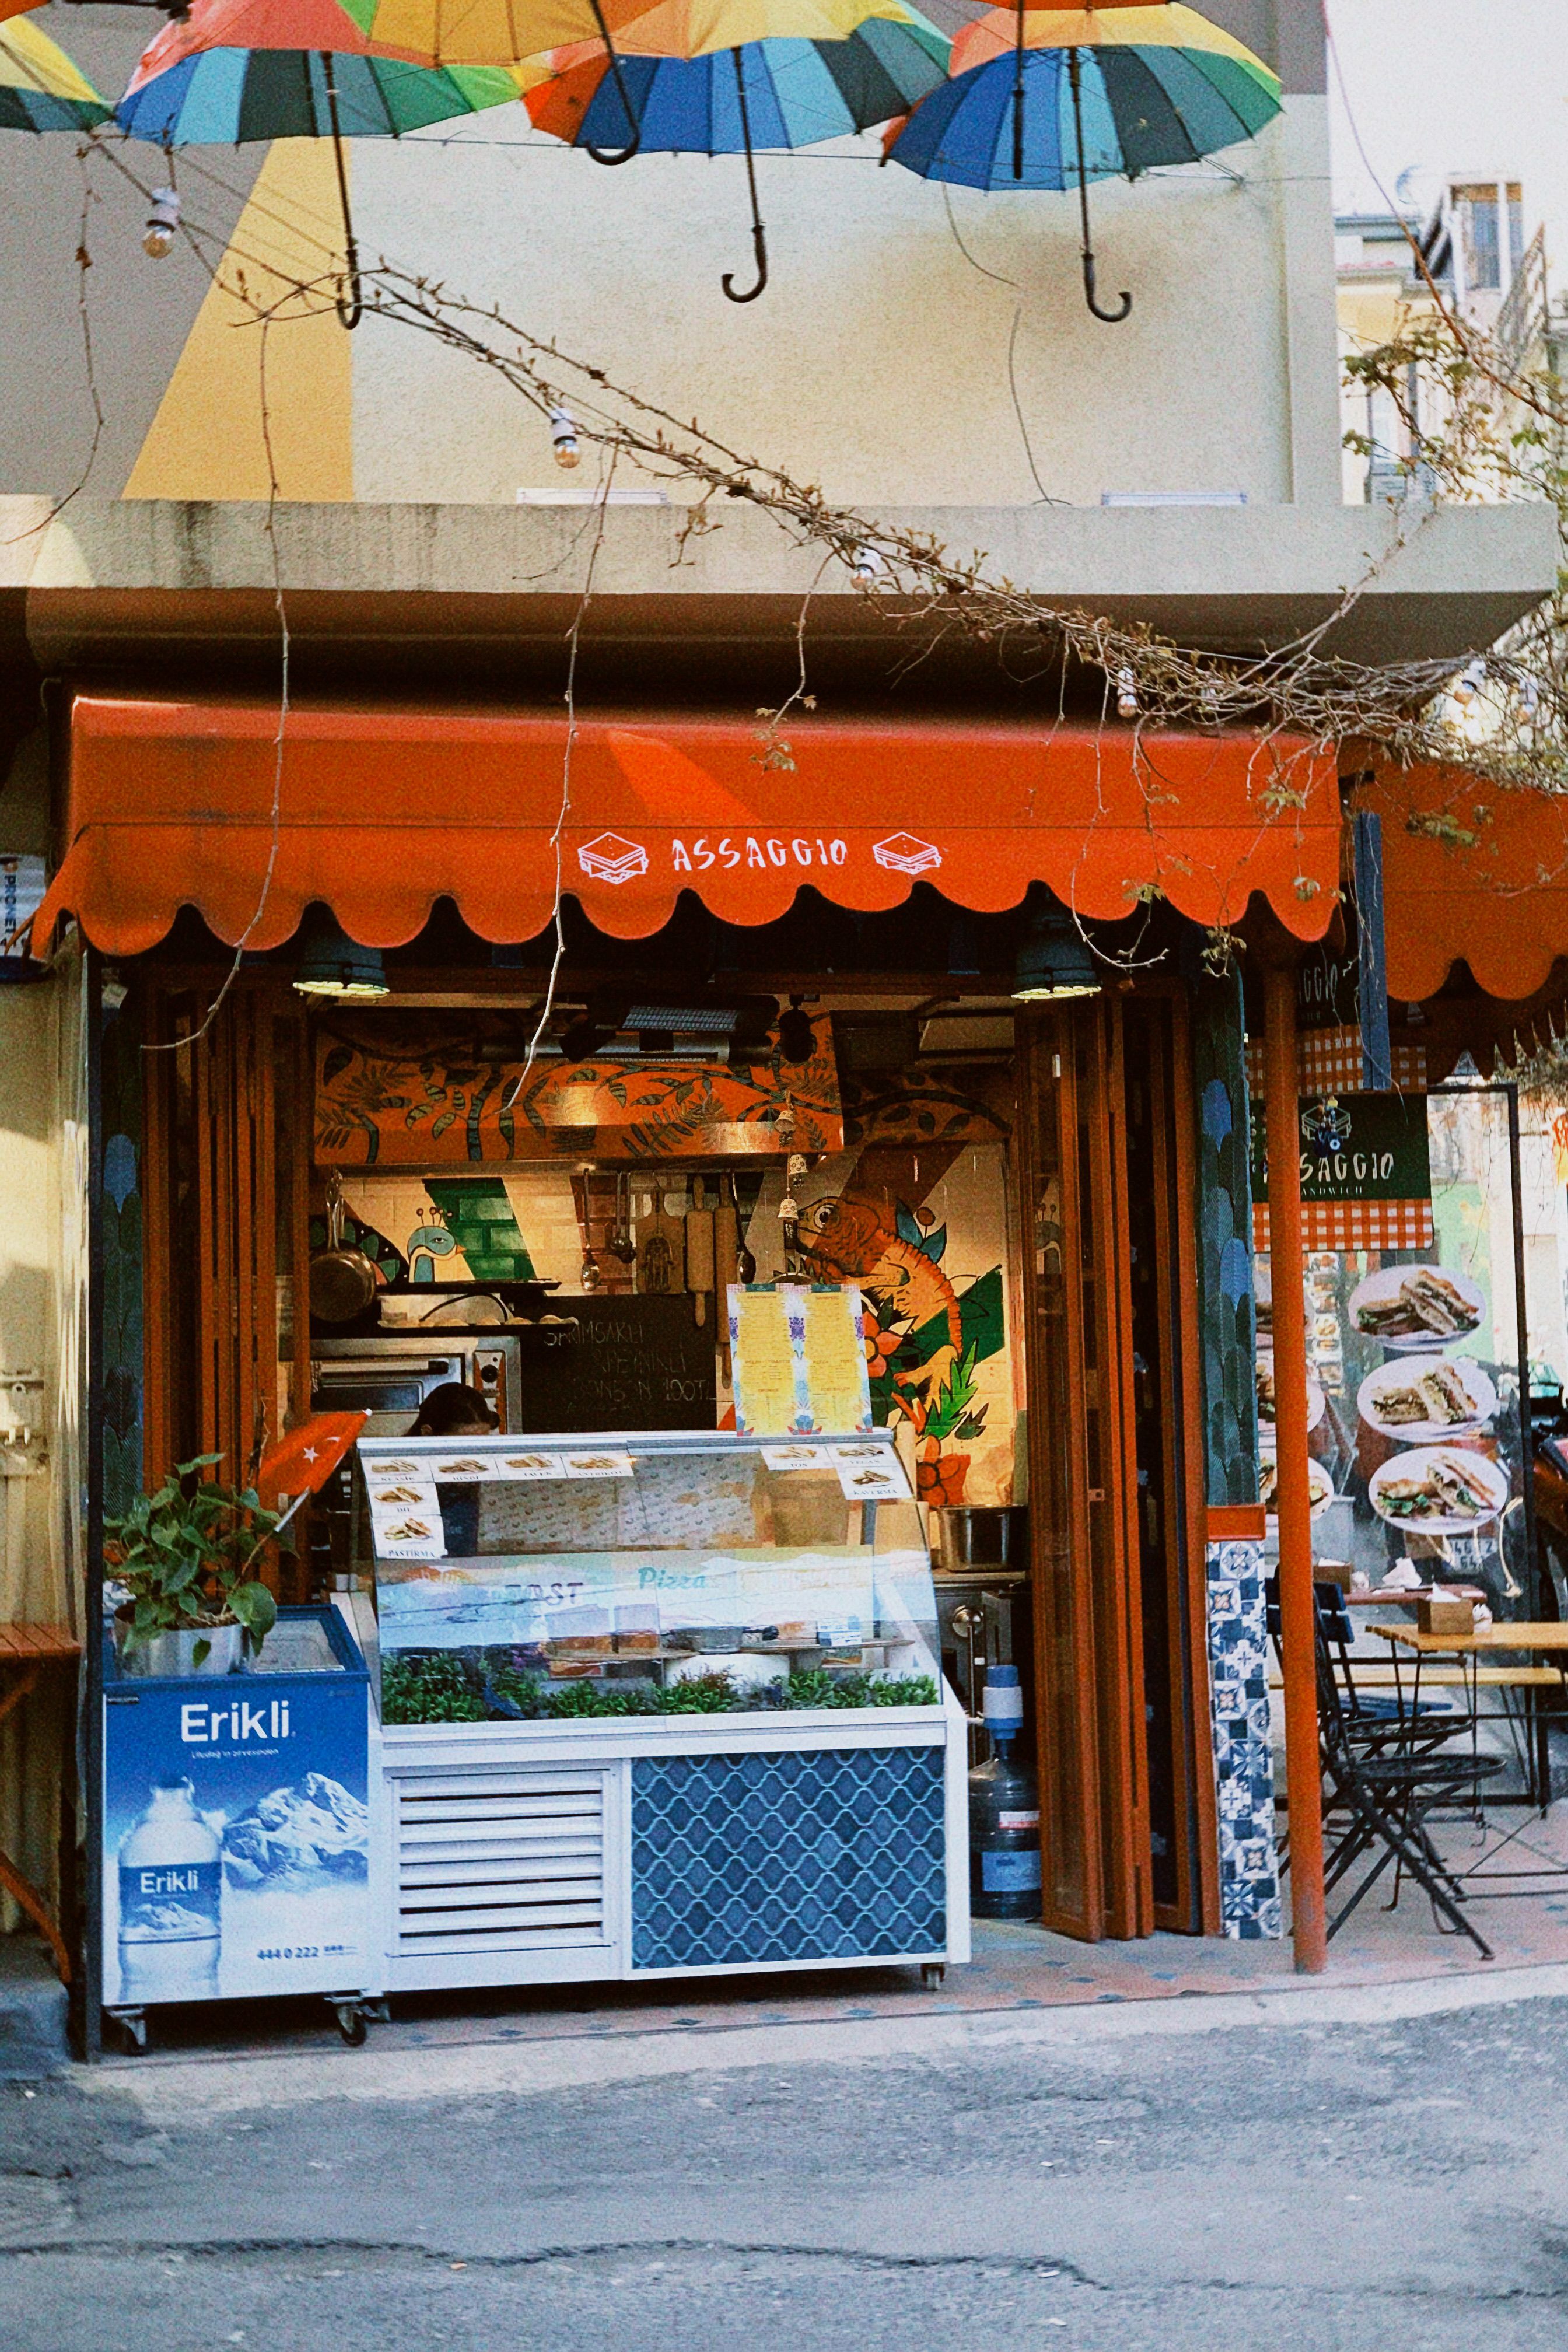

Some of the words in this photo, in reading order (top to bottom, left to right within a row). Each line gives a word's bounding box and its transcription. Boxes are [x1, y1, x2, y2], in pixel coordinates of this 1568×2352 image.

[671, 836, 848, 871] ASSAGGIO
[1301, 1186, 1362, 1196] ANDWICH
[638, 1567, 705, 1590] Pizza
[181, 1700, 289, 1742] Erikli
[141, 1870, 198, 1894] Erikli
[257, 1948, 281, 1960] 444
[295, 1946, 319, 1958] 222
